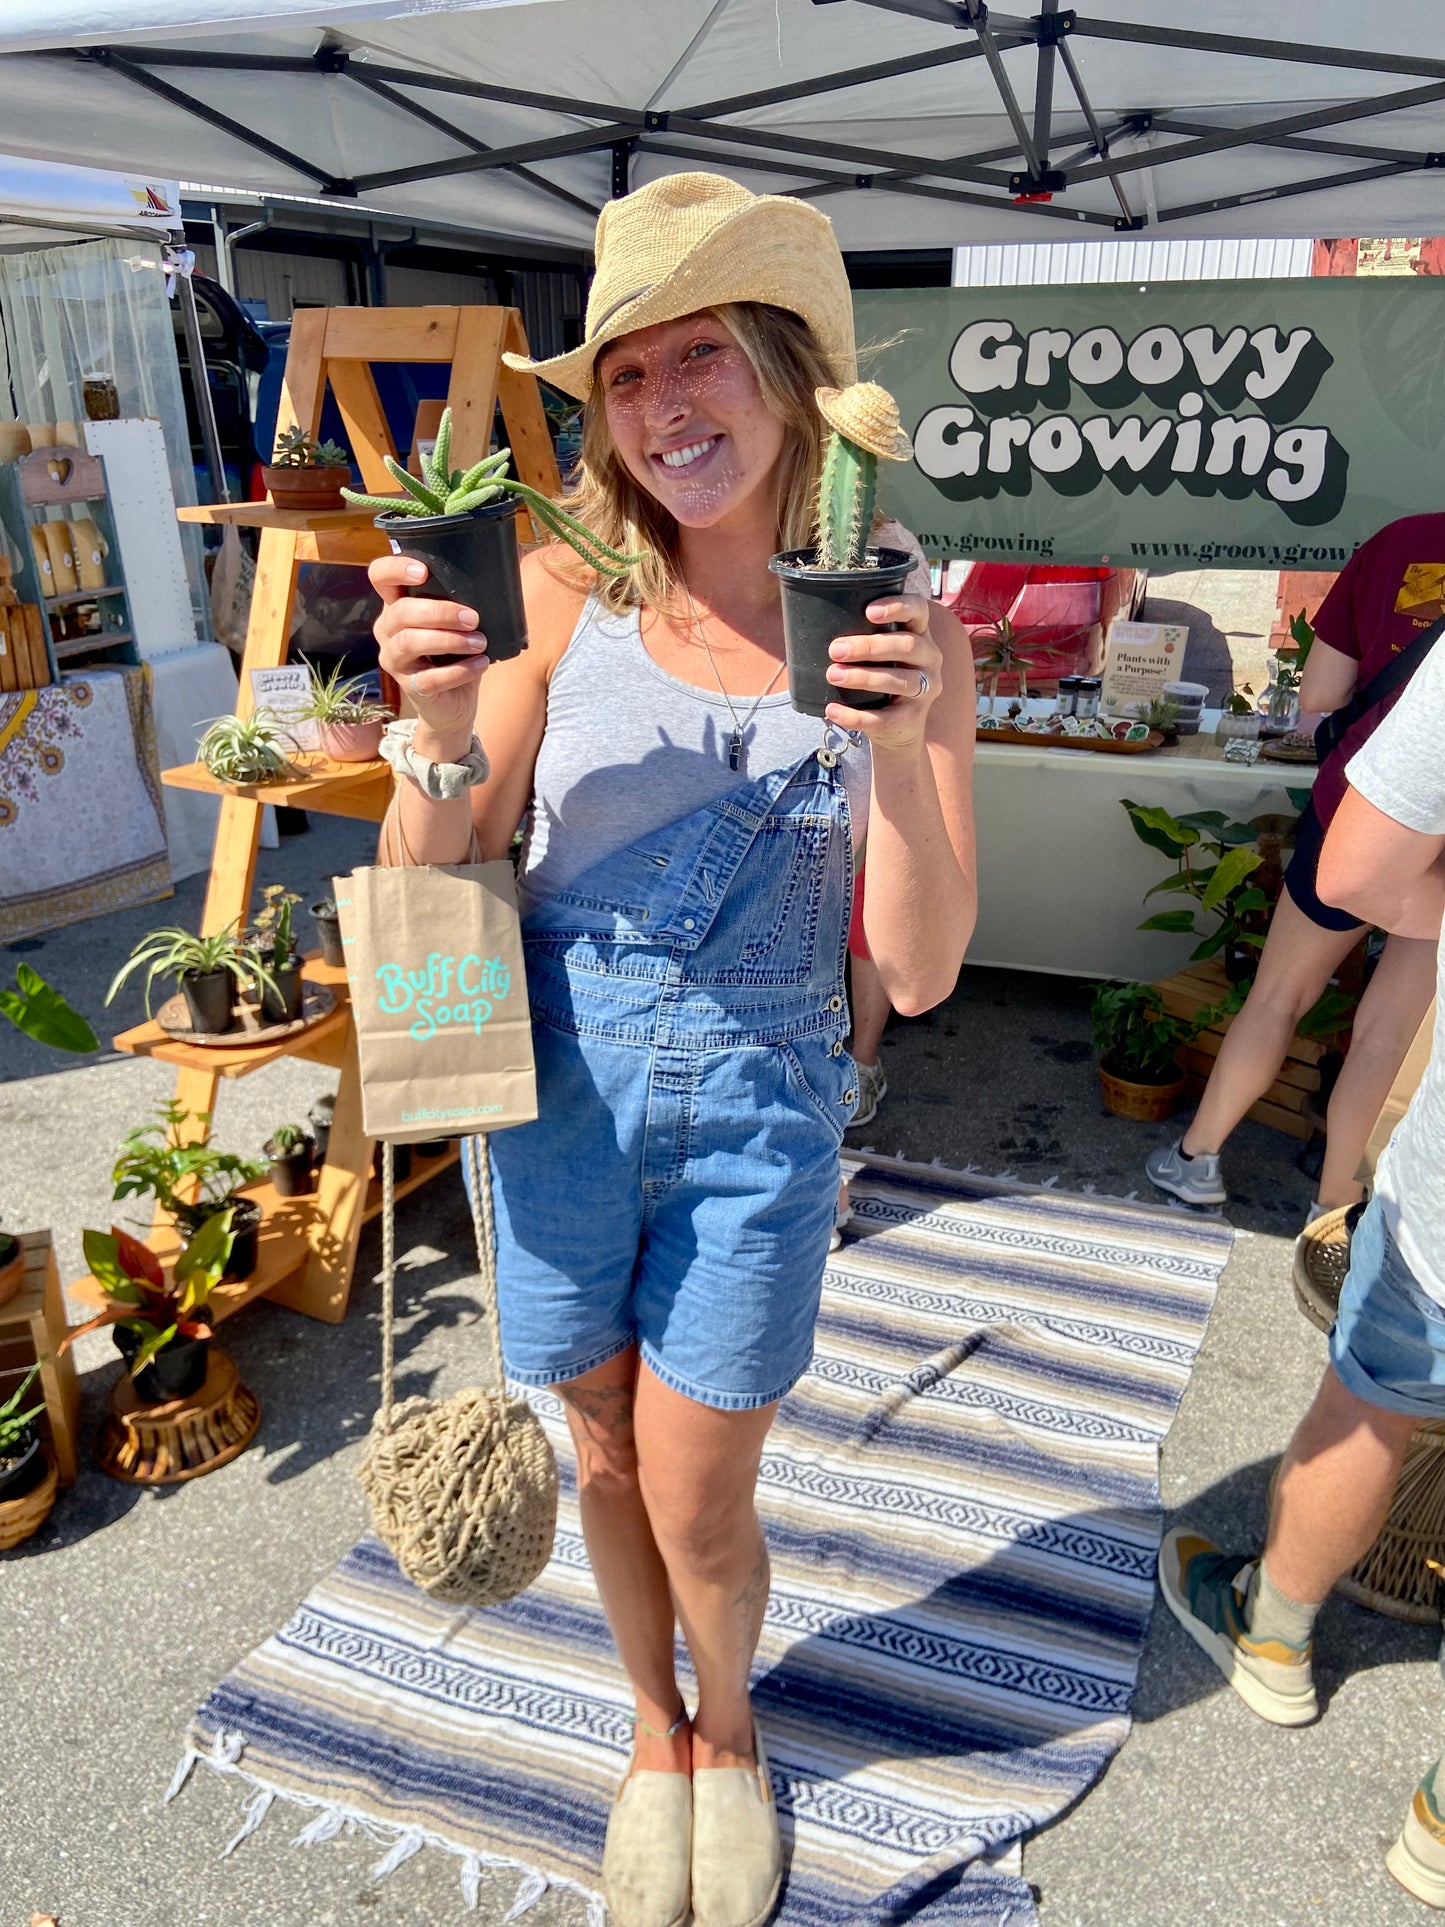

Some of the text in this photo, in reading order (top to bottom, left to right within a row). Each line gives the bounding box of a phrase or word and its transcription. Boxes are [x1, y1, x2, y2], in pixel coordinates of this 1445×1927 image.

[949, 319, 1316, 402] Groovy
[913, 391, 1329, 502] Growing
[917, 532, 1055, 557] ovy.growing
[1130, 541, 1360, 566] www.groovygrowi
[1117, 653, 1170, 666] Plants with
[1125, 664, 1167, 675] Purpose!
[375, 952, 511, 1014] Buff City
[410, 998, 493, 1042] Soap
[401, 1104, 502, 1123] buffcitysoap.com
